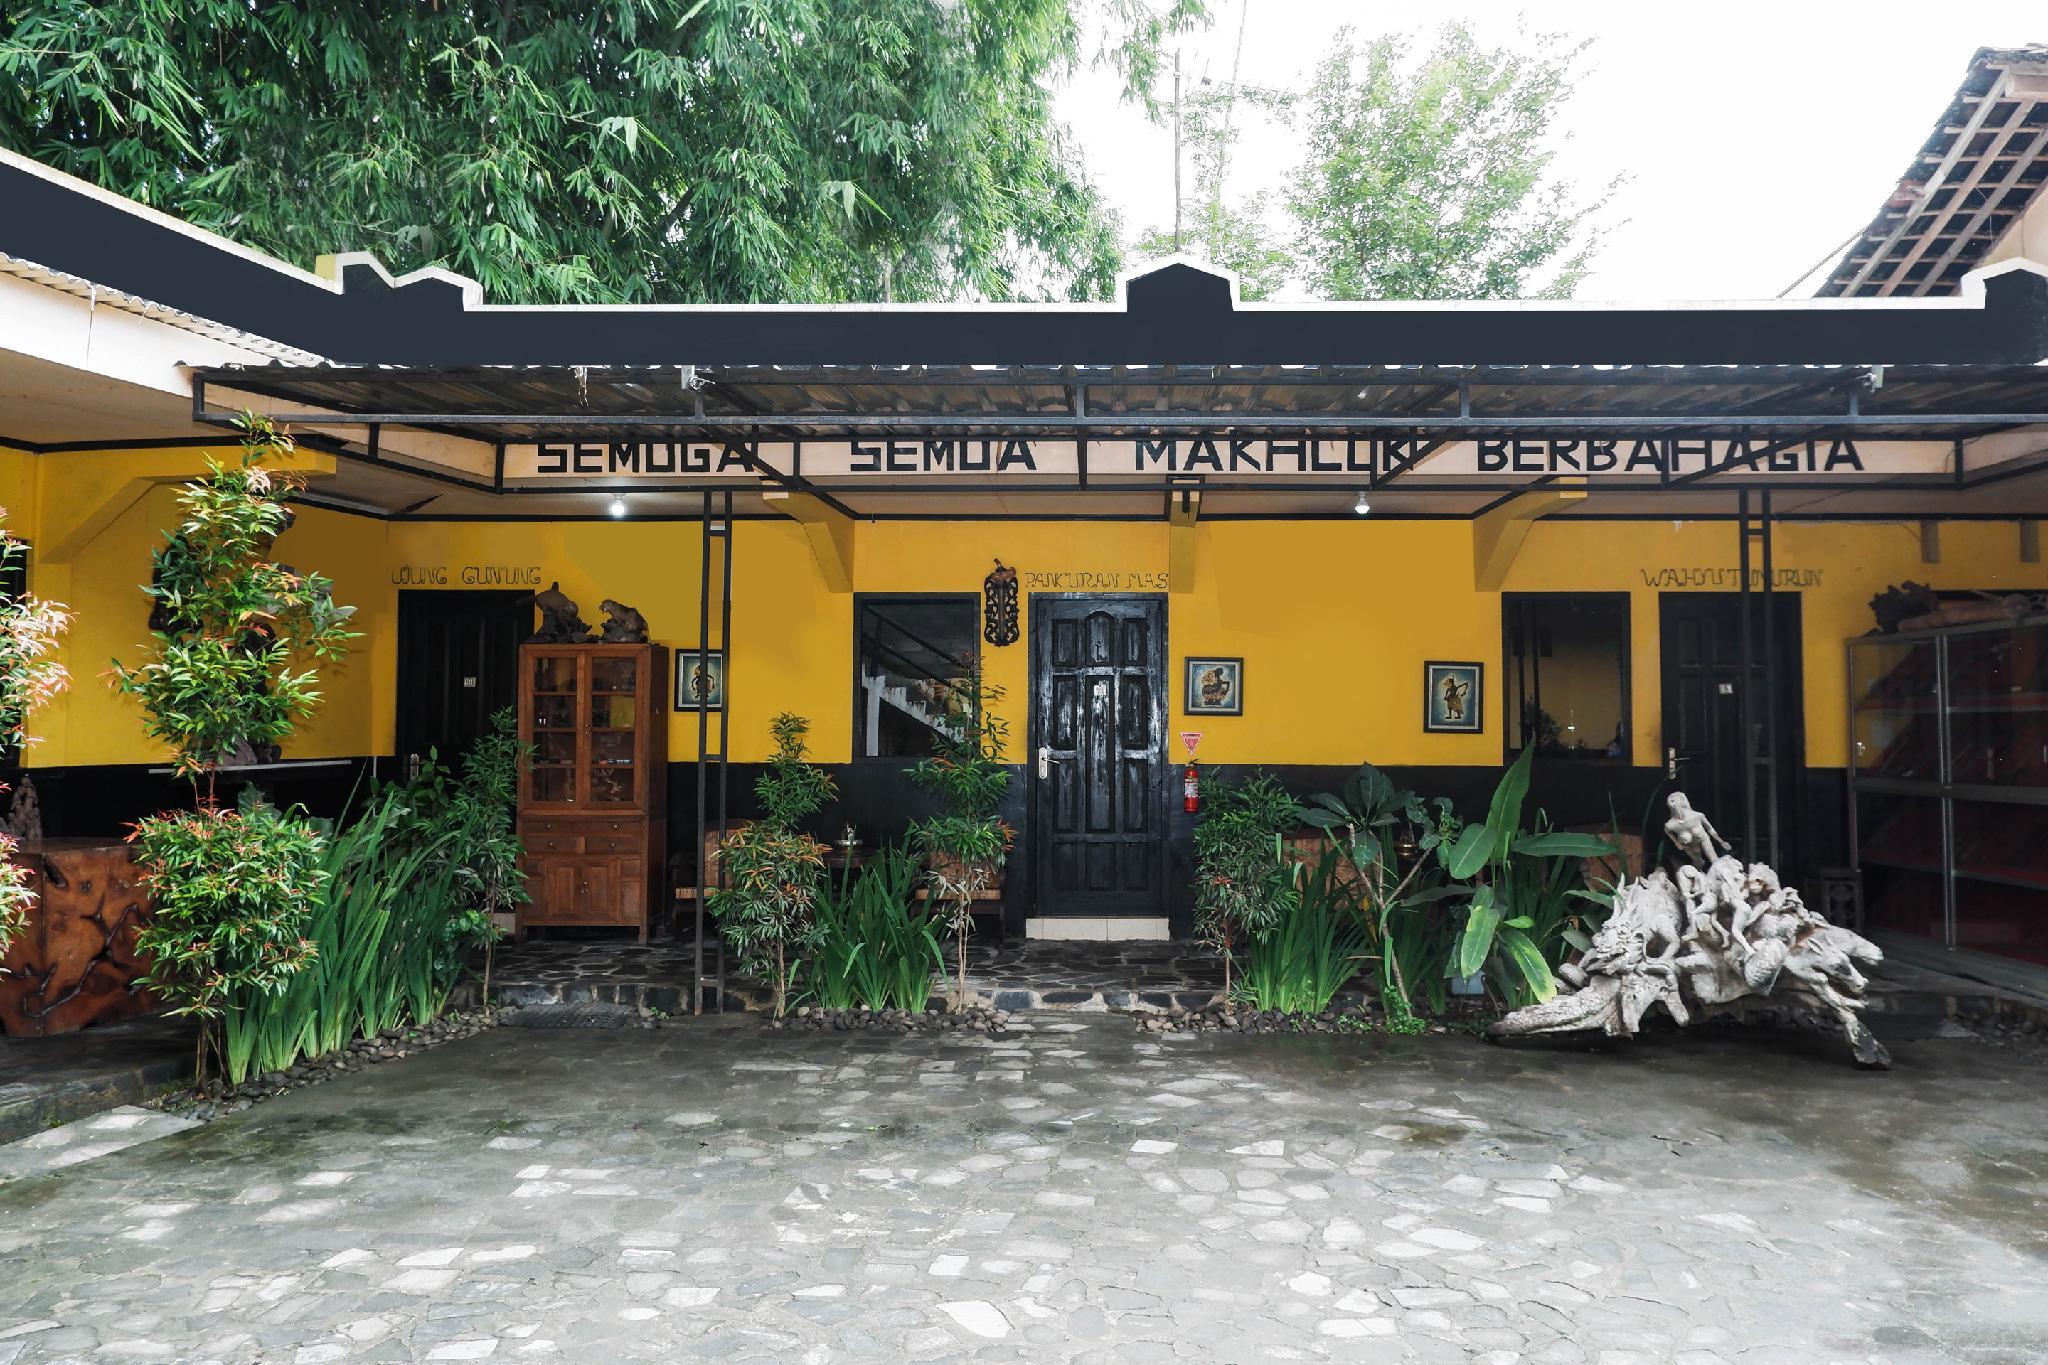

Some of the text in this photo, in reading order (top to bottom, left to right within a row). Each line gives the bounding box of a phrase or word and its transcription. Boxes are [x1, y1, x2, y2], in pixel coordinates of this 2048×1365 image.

[850, 441, 1037, 472] SEMUA
[1135, 440, 1414, 472] MAKHLUK
[1477, 440, 1864, 472] BERBAHAGIA
[1125, 572, 1169, 588] MAS
